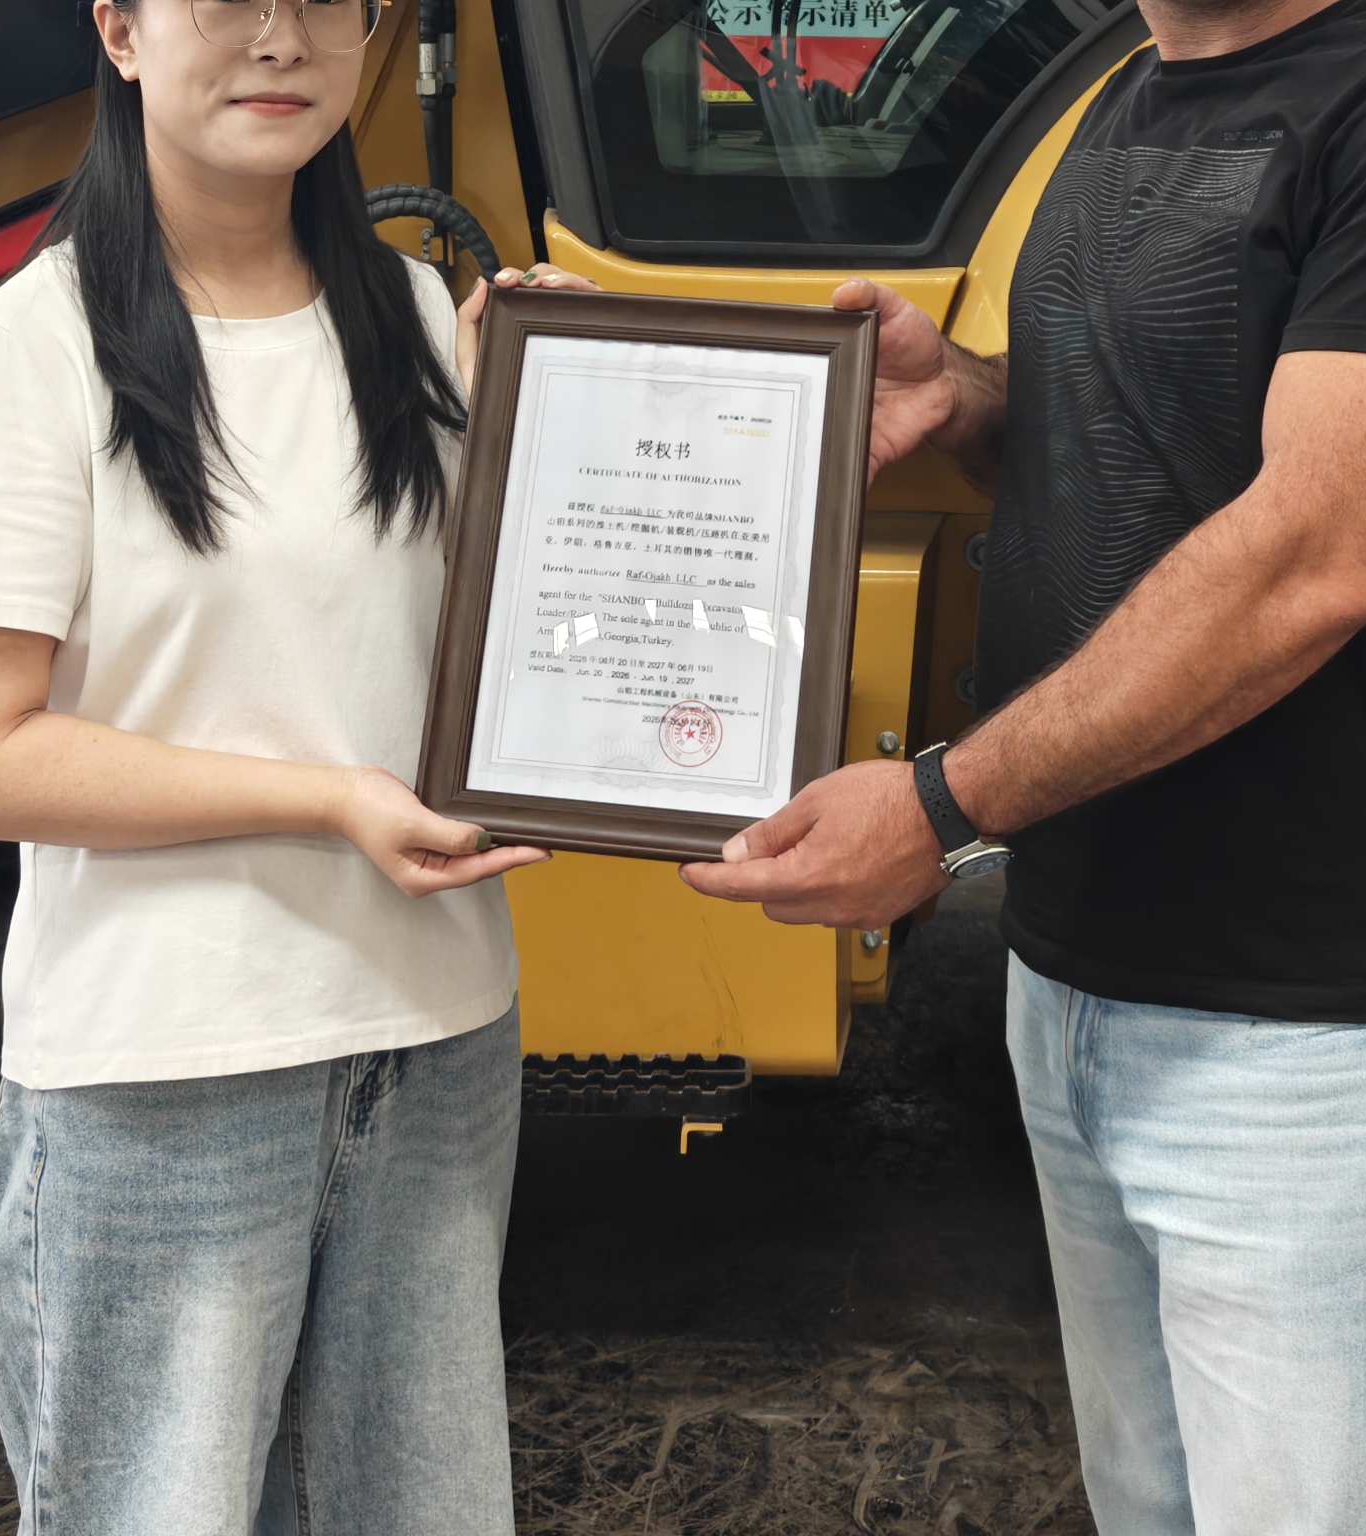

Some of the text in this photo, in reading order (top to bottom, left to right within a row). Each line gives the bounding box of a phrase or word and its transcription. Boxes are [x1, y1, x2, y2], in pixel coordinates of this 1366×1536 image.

[635, 438, 690, 460] 授权书
[579, 466, 742, 487] CERTIFICATE OF AUTHORIZATION
[542, 563, 574, 575] Hereby
[578, 567, 621, 579] authorize
[706, 578, 716, 586] as
[718, 577, 732, 587] the
[734, 578, 756, 589] sales
[539, 590, 561, 602] agent
[564, 590, 577, 601] for
[579, 591, 593, 602] the
[601, 612, 618, 621] The
[620, 614, 638, 624] sole
[666, 618, 674, 627] in
[677, 618, 691, 629] the
[734, 623, 745, 633] of
[528, 664, 545, 672] Valid
